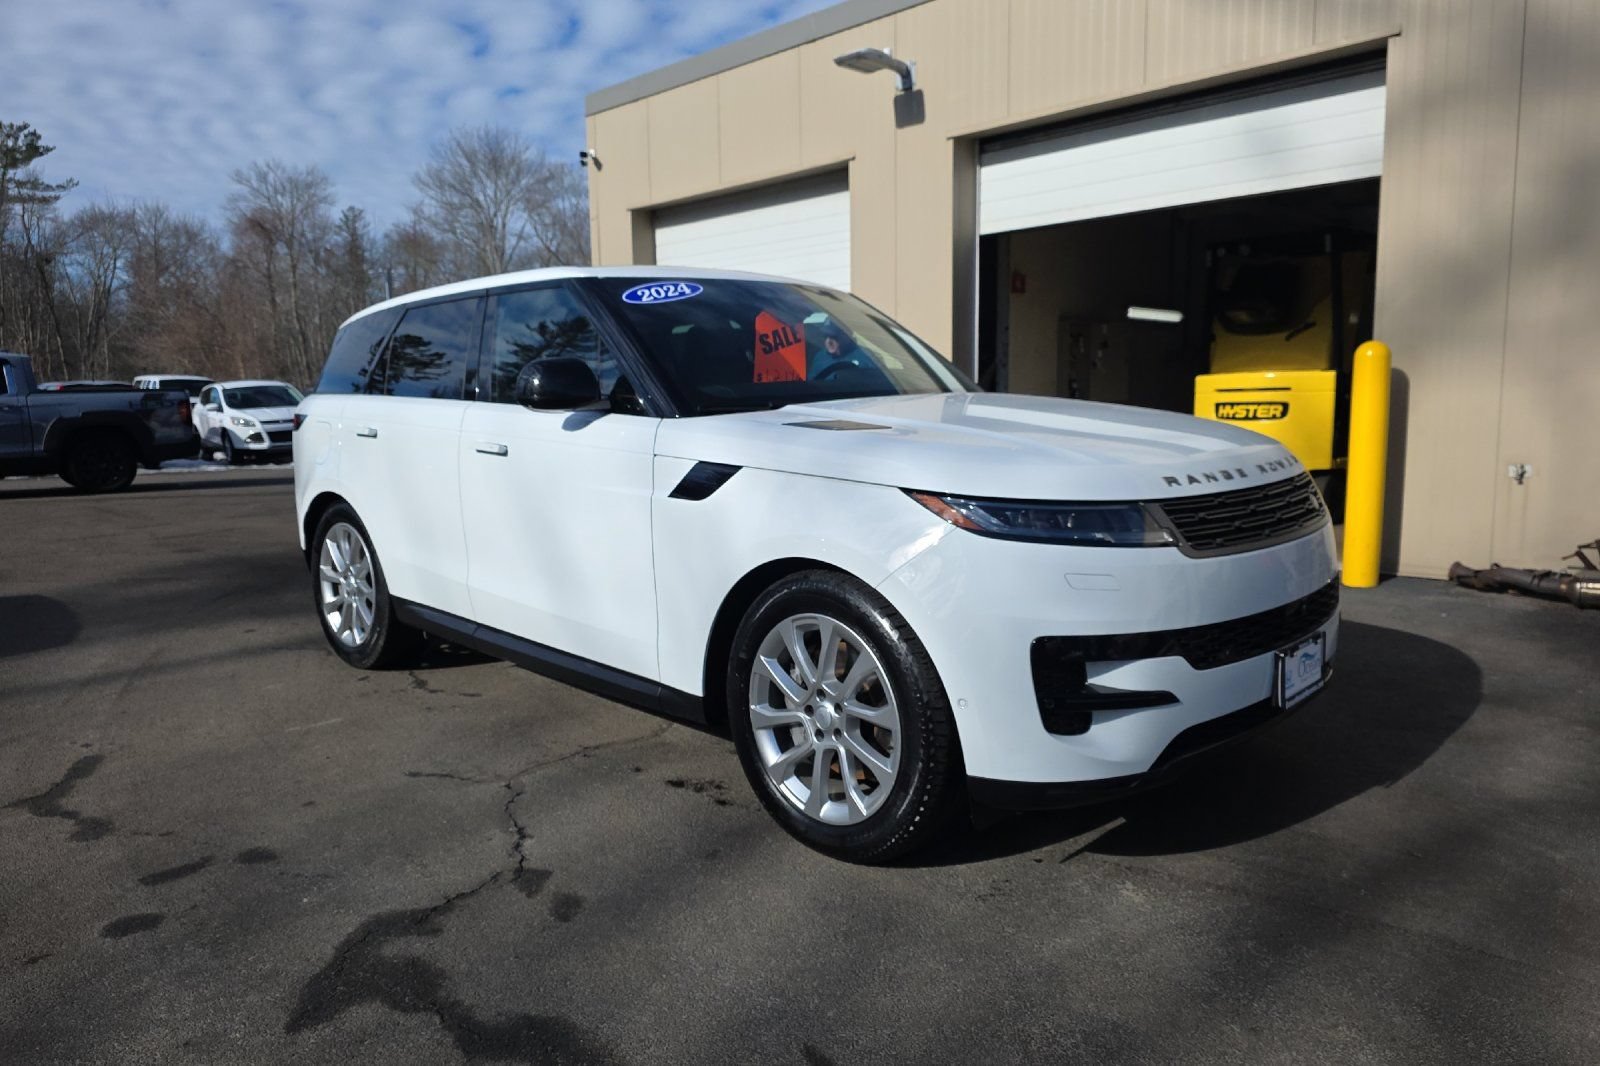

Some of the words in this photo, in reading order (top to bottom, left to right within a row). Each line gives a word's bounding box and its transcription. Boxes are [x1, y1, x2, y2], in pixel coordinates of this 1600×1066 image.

[637, 283, 691, 301] 2024
[1218, 404, 1284, 418] HYSTER
[1162, 468, 1248, 487] RANGE
